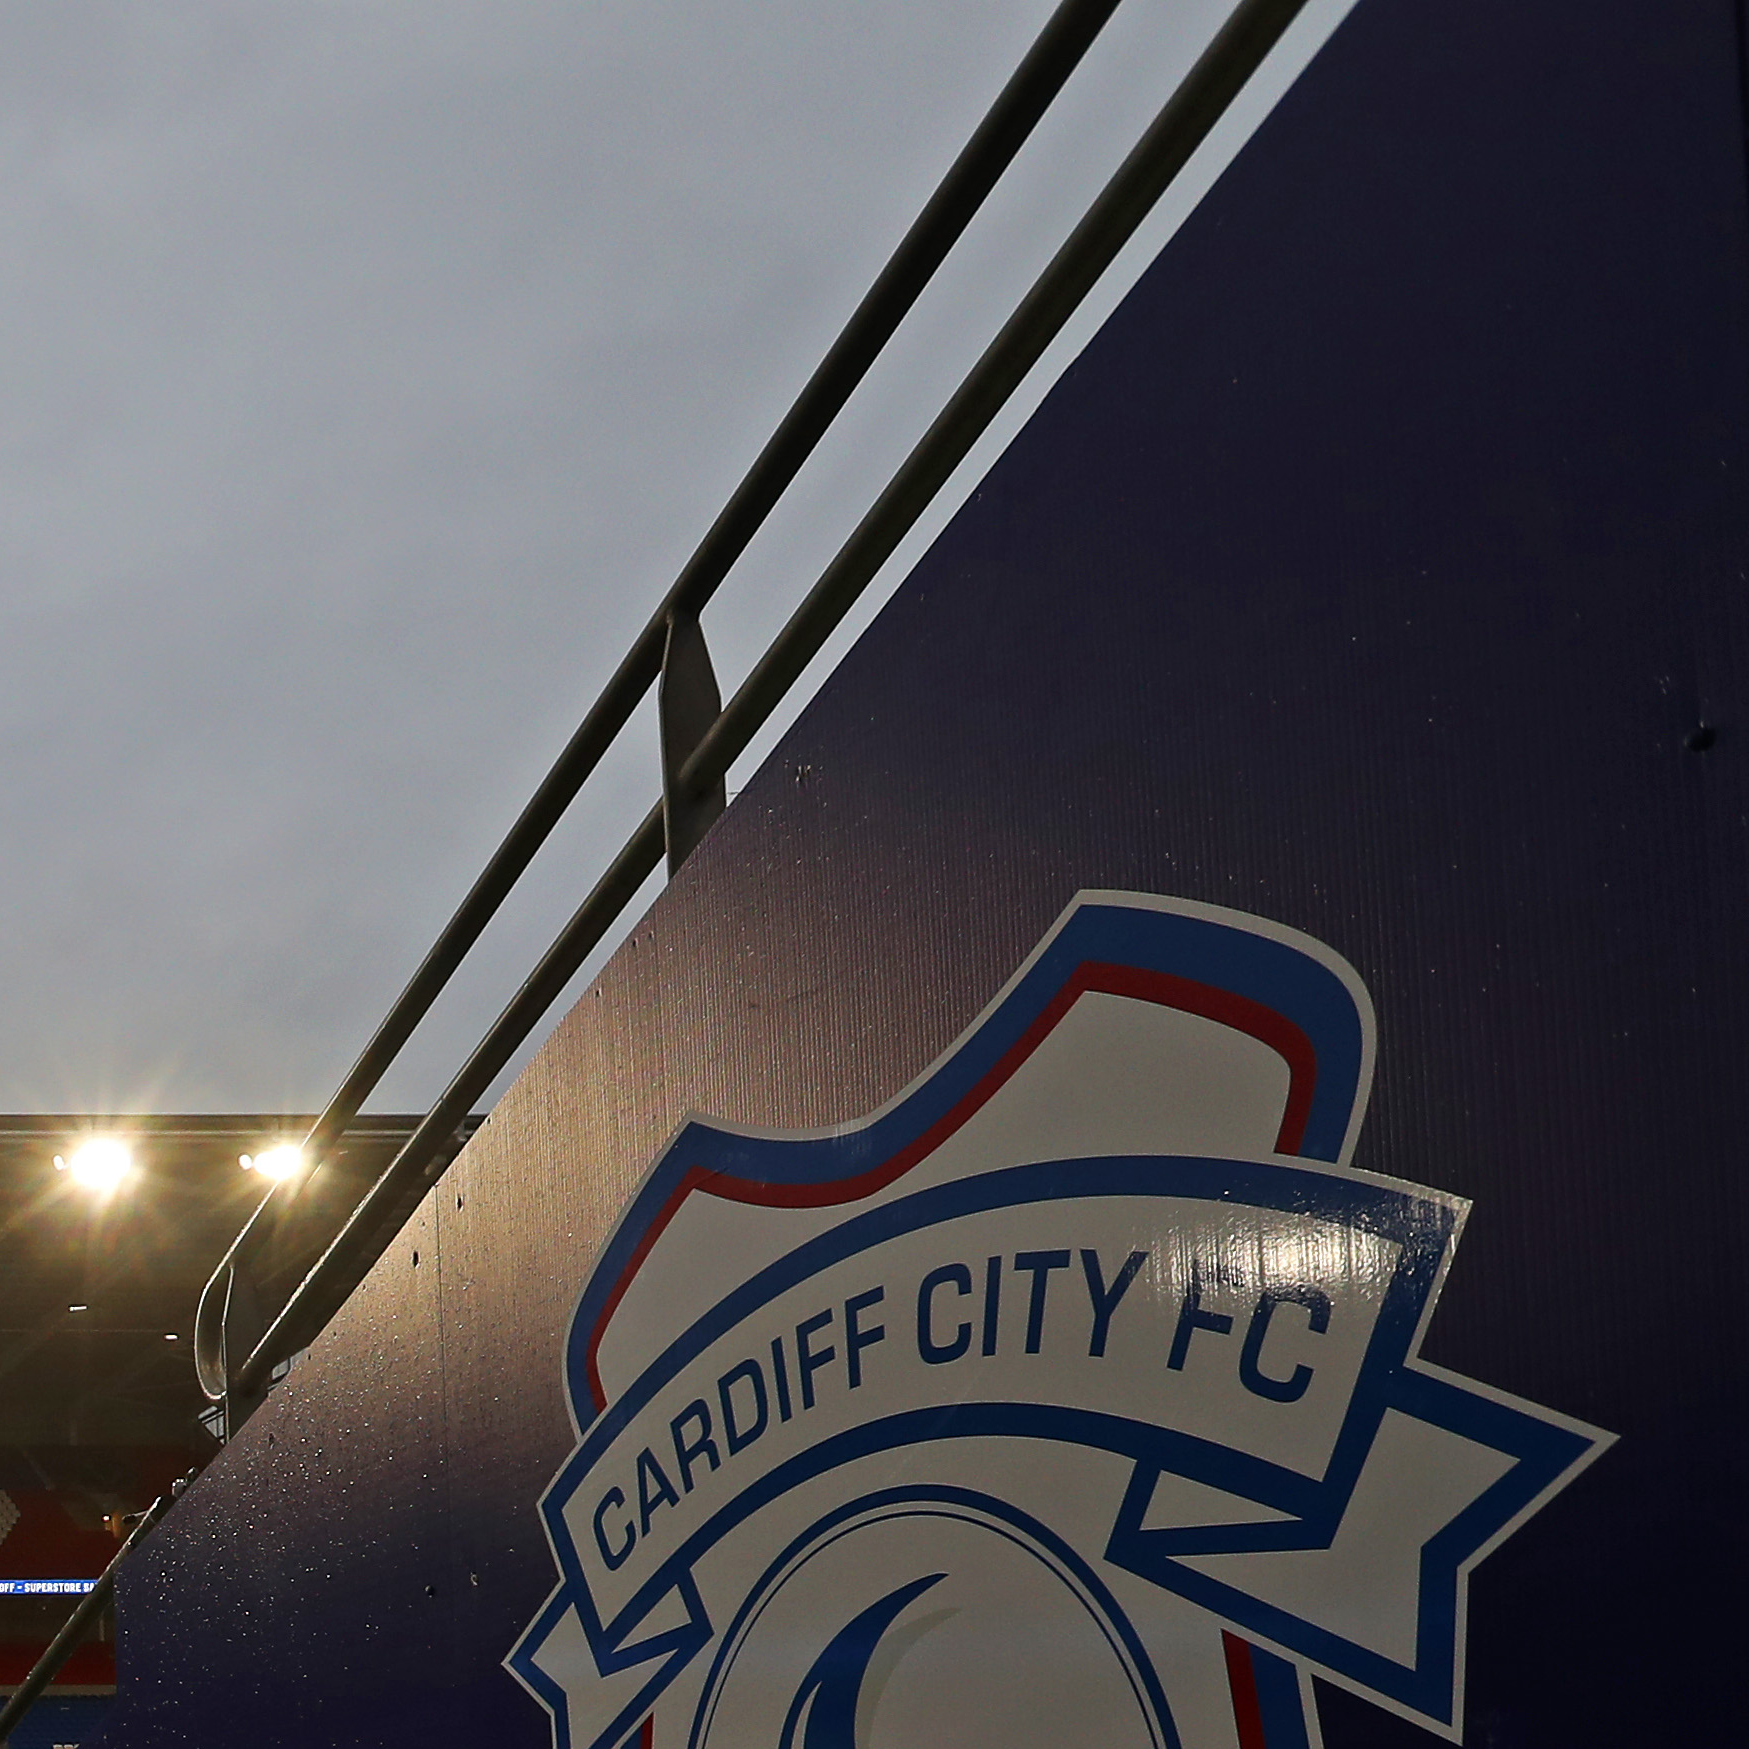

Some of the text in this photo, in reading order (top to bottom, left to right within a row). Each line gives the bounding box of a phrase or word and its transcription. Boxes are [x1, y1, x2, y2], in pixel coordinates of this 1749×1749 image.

[591, 1249, 1332, 1573] CARDIFF CITY FC
[0, 1583, 15, 1593] OFF
[24, 1583, 82, 1593] SUPERSTORE
